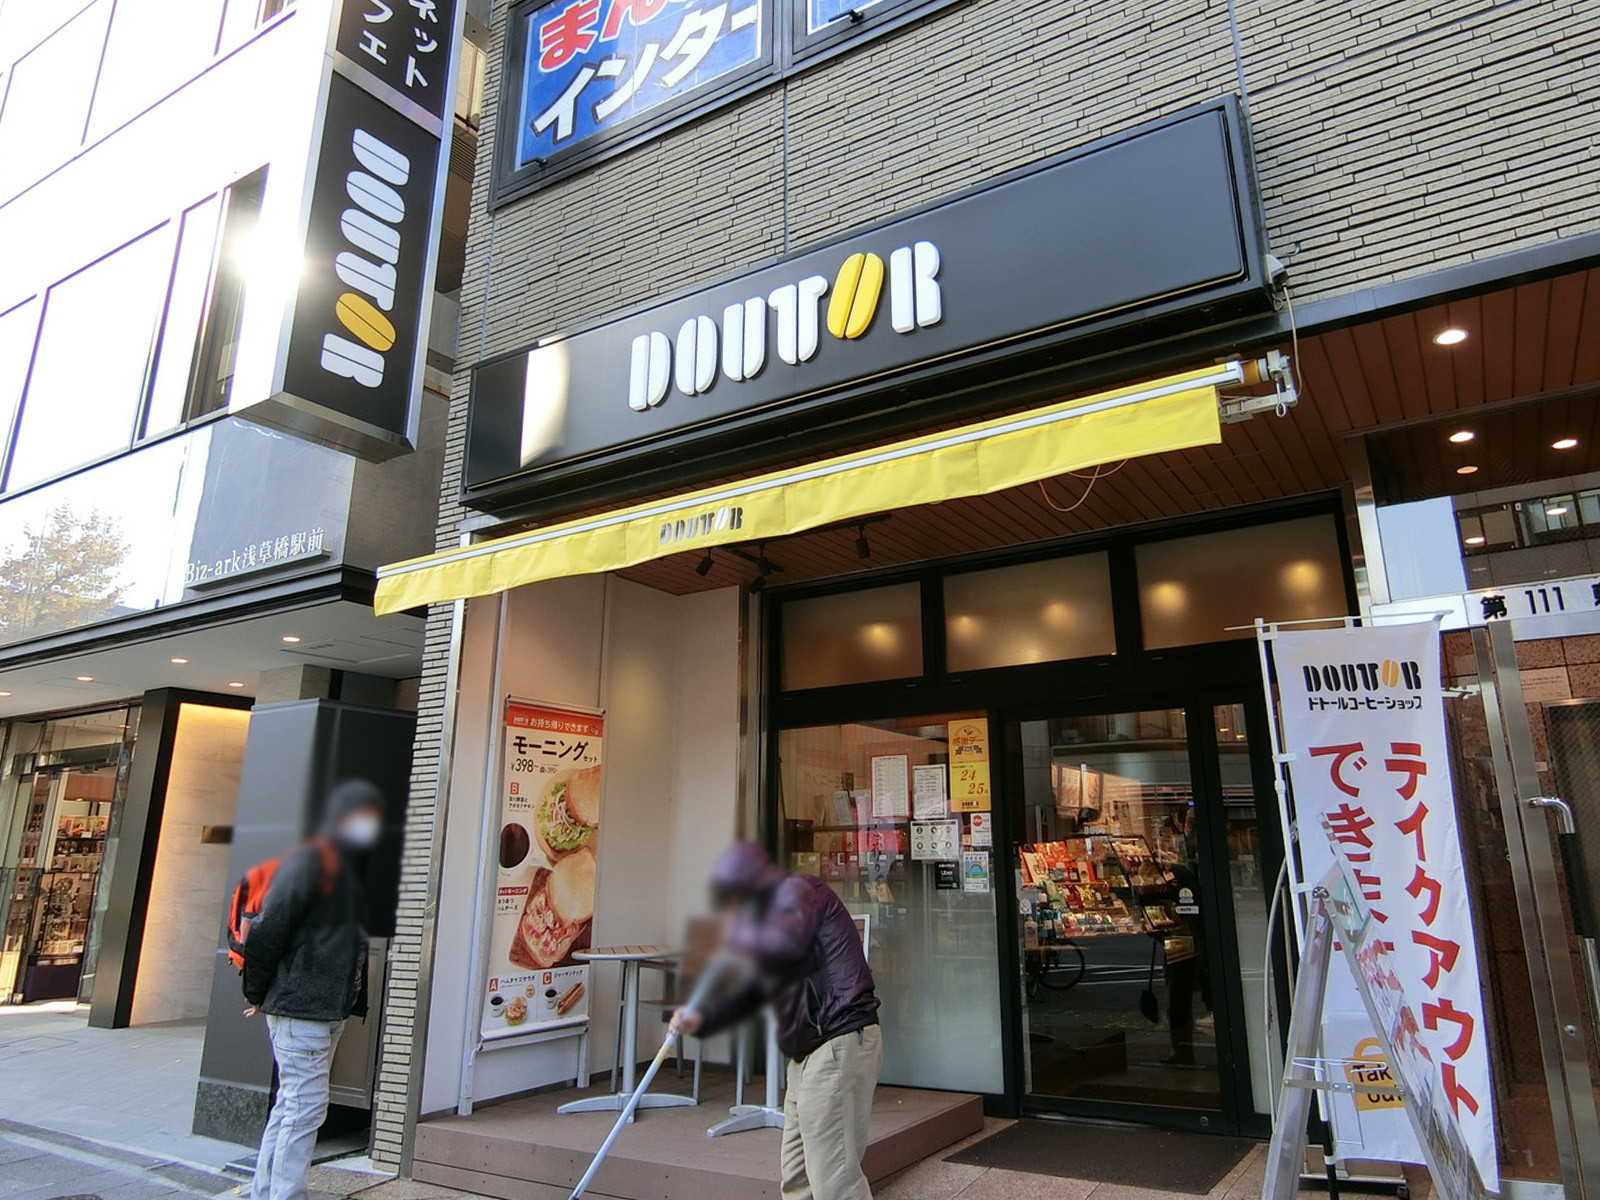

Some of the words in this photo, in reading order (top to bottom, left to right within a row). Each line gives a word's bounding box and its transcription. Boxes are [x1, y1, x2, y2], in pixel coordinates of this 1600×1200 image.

[539, 0, 694, 72] まん
[320, 127, 411, 389] DOUTOR
[628, 240, 943, 412] DOUTOR
[659, 506, 744, 545] DOUTOR
[1524, 586, 1565, 615] 111
[1302, 659, 1422, 692] DOUTOR
[1308, 696, 1423, 711] ドトールコーヒーショップ
[530, 717, 589, 733] お持ち帰りできます
[960, 769, 977, 782] 24
[1308, 741, 1395, 952] でき
[1383, 741, 1480, 1123] テイクアウト
[1352, 1063, 1394, 1083] Tak
